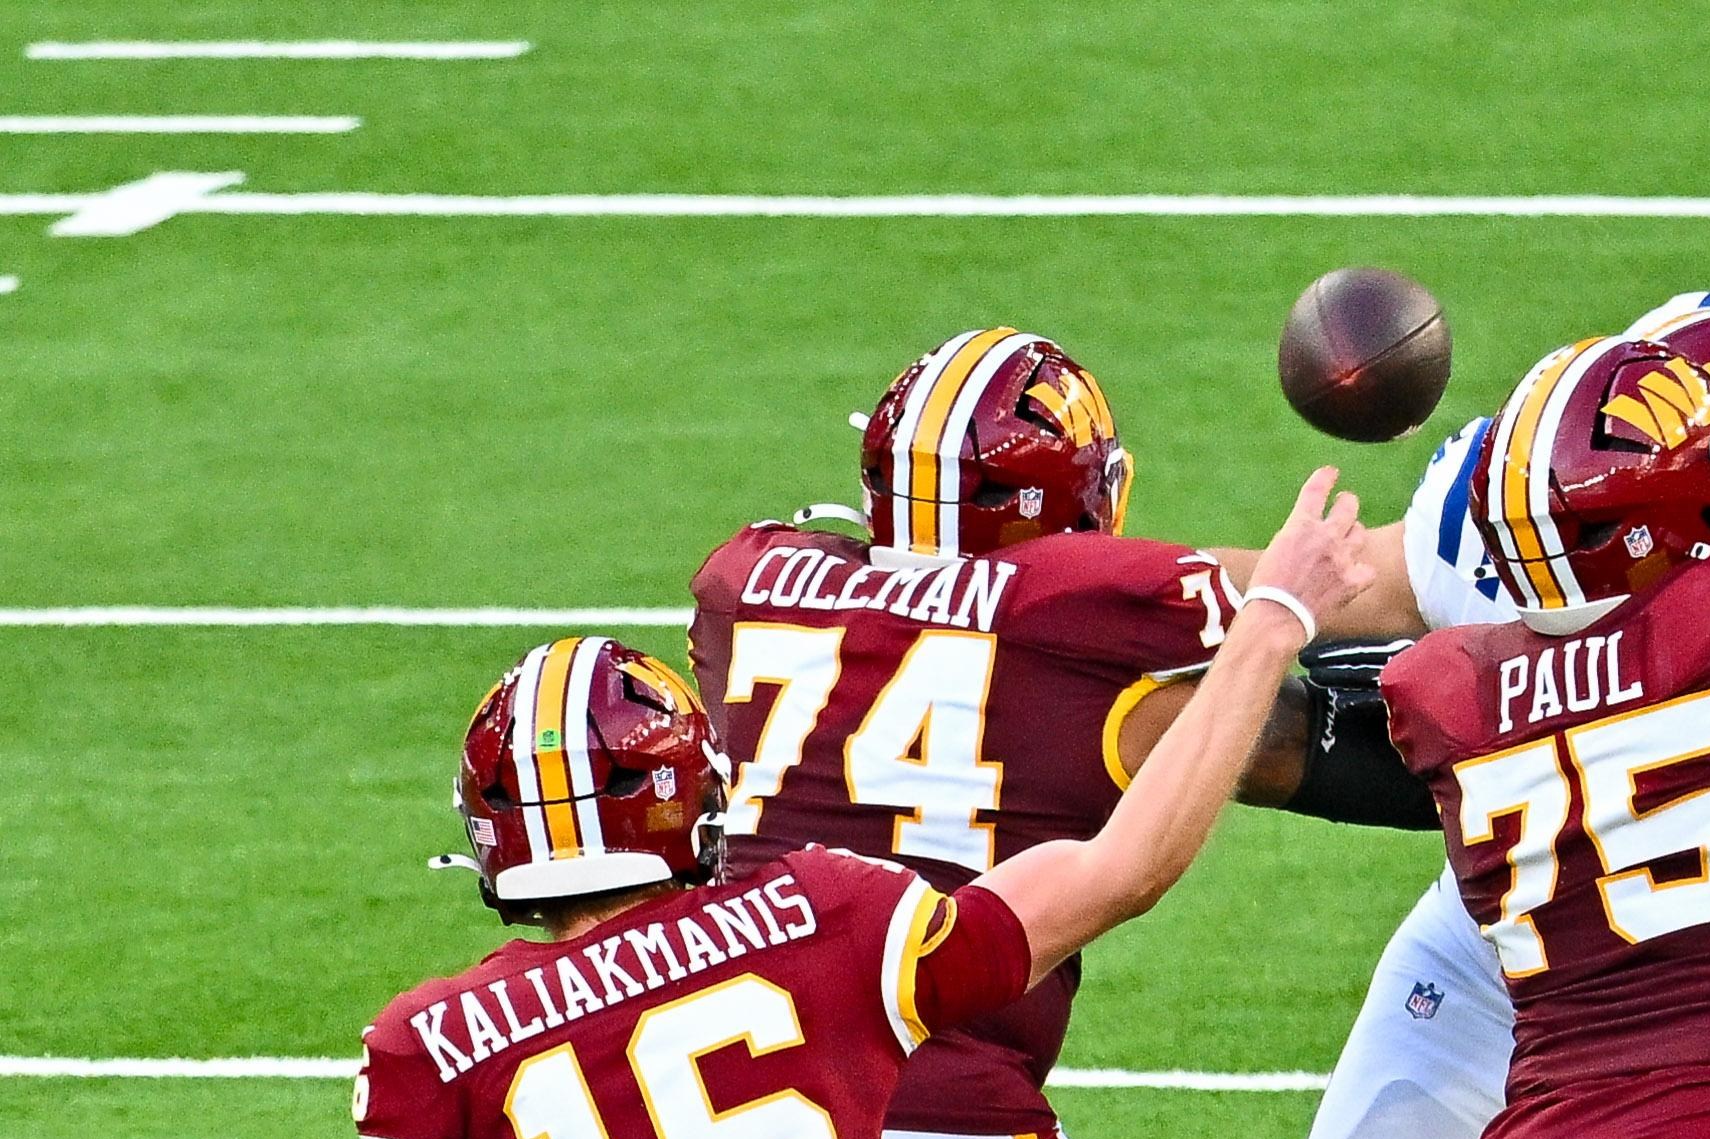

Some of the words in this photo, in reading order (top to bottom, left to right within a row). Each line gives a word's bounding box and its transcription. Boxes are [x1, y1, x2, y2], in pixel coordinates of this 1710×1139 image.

[741, 547, 1017, 632] COLEMAN
[723, 621, 1004, 873] 74
[1499, 630, 1643, 732] PAUL
[411, 875, 817, 1084] KALIAKMANIS
